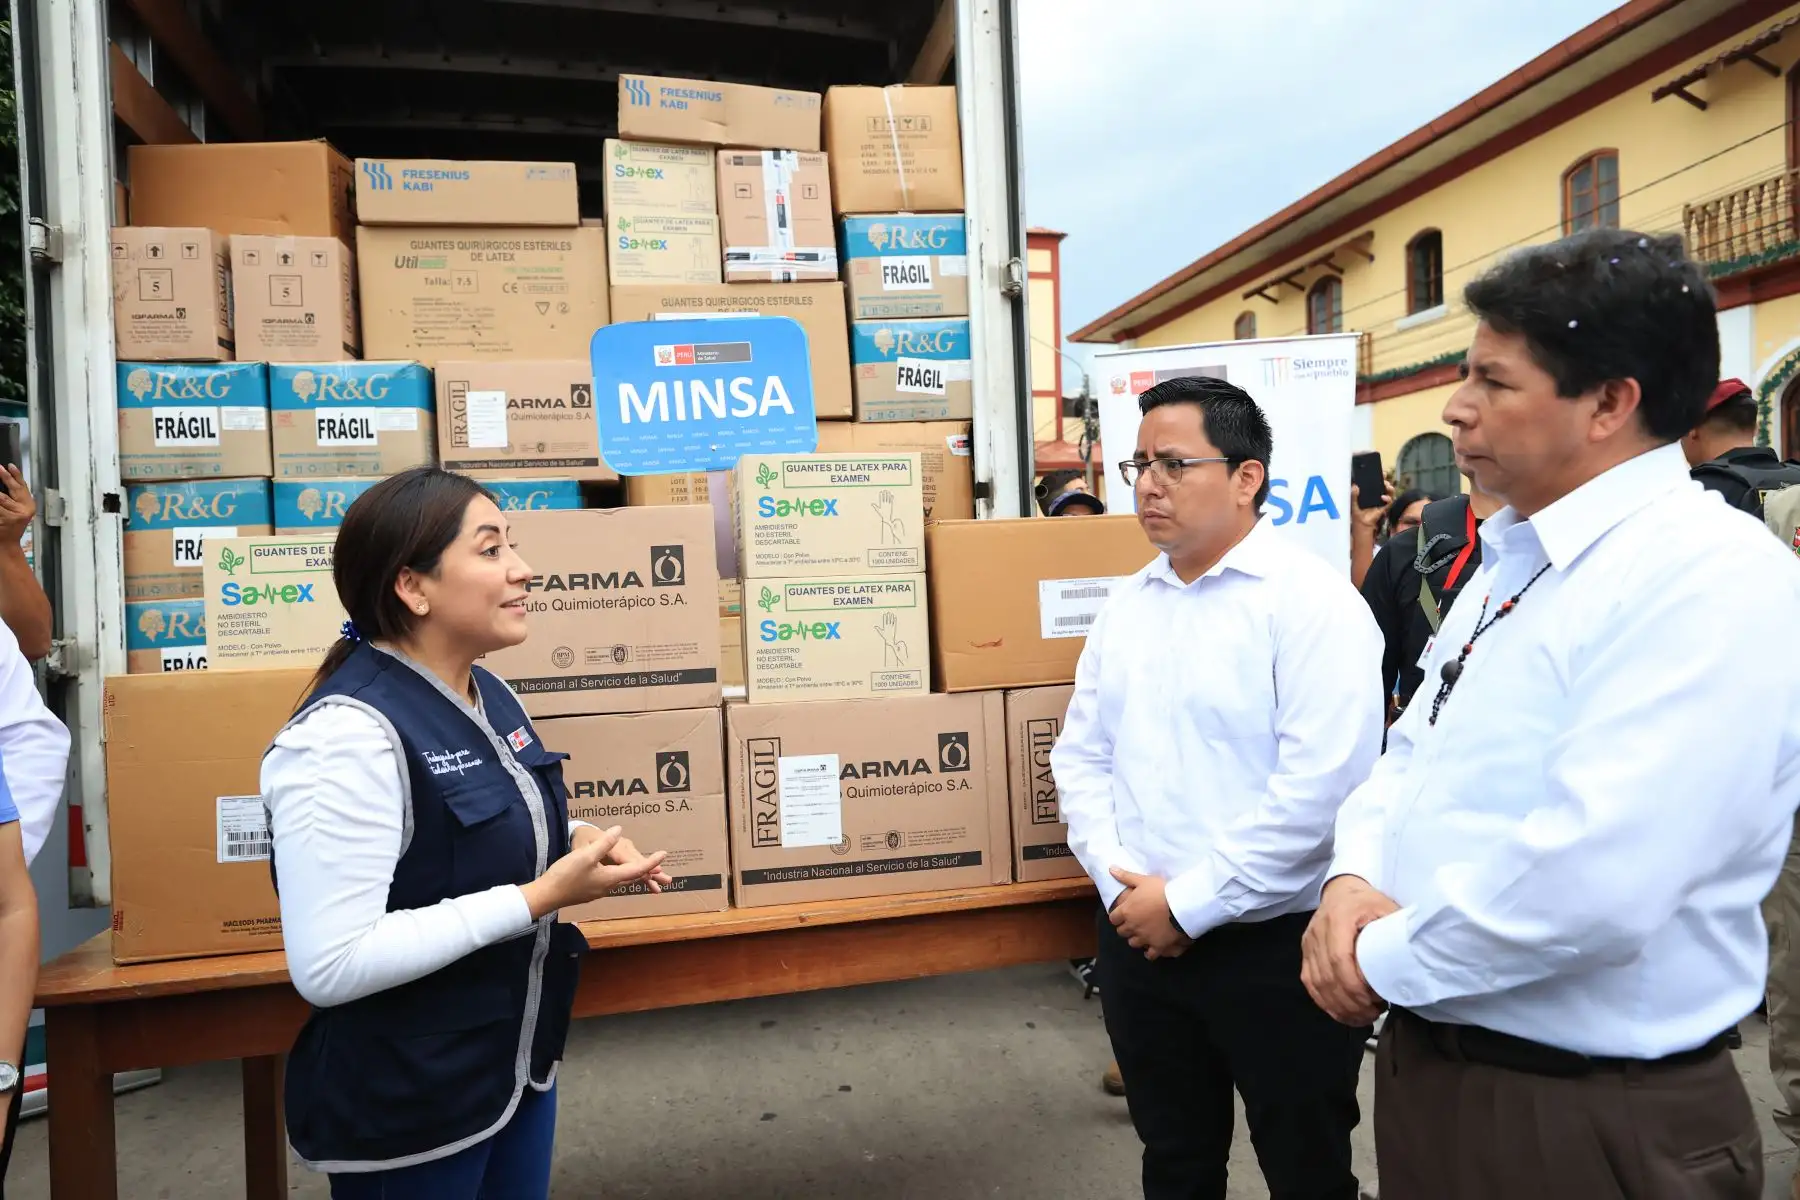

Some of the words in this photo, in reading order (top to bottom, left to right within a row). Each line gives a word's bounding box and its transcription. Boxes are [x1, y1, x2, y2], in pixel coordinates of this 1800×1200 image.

[660, 87, 722, 102] FRESENIUS
[660, 99, 688, 110] KABI
[402, 169, 470, 180] FRESENIUS
[403, 182, 433, 192] KABI
[888, 224, 949, 250] R&G
[410, 240, 455, 251] GUANTES
[394, 254, 419, 270] Util
[470, 252, 484, 262] DE
[486, 252, 515, 262] LATEX
[883, 260, 930, 285] FRÁGIL
[152, 282, 160, 292] 5
[424, 277, 451, 286] Talla:
[283, 288, 290, 298] 5
[661, 297, 704, 307] GUANTES
[894, 329, 956, 354] R&G
[1293, 358, 1348, 371] Siempre
[897, 364, 944, 389] FRÁGIL
[152, 372, 231, 399] R&G
[316, 373, 390, 401] R&G
[507, 398, 566, 409] ARMA
[618, 375, 795, 425] MINSA
[452, 382, 468, 446] FRAGIL
[511, 411, 574, 422] Quimioterápico
[155, 411, 216, 439] FRÁGIL
[317, 413, 374, 439] FRÁGIL
[786, 463, 832, 473] GUANTES
[834, 463, 848, 472] DE
[850, 463, 880, 472] LATEX
[882, 462, 907, 471] PARA
[830, 474, 870, 483] EXAMEN
[160, 491, 237, 521] R&G
[755, 523, 798, 531] AMBIDIESTRO
[175, 534, 203, 561] FRÁ
[254, 547, 308, 557] GUANTES
[310, 546, 326, 555] DE
[525, 571, 645, 592] FARMA
[788, 586, 835, 596] GUANTES
[837, 586, 851, 594] DE
[853, 585, 883, 594] LATEX
[885, 584, 911, 593] PARA
[552, 595, 656, 614] Quimioterápico
[659, 593, 688, 606] S.A.
[833, 597, 874, 606] EXAMEN
[217, 612, 268, 621] AMBIDIESTRO
[164, 611, 207, 640] R&
[217, 621, 229, 629] NO
[217, 627, 271, 637] DESCARTABLE
[756, 647, 800, 655] AMBIDIESTRO
[163, 652, 208, 671] FRÁG
[756, 662, 803, 670] DESCARTABLE
[521, 679, 567, 692] Nacional
[568, 678, 579, 689] al
[580, 676, 621, 688] Servicio
[623, 674, 637, 685] de
[638, 674, 648, 684] la
[650, 672, 683, 684] Salud"
[840, 758, 932, 781] ARMA
[1033, 721, 1057, 821] FRAGIL
[754, 740, 778, 845] FRAGIL
[846, 781, 943, 800] Quimioterápico
[946, 779, 973, 792] S.A.
[665, 799, 693, 813] S.A.
[763, 868, 809, 882] "Industria
[811, 865, 853, 878] Nacional
[856, 864, 864, 874] al
[866, 860, 904, 873] Servicio
[906, 858, 918, 870] de
[920, 857, 929, 868] la
[931, 855, 961, 868] Salud"
[629, 882, 642, 893] de
